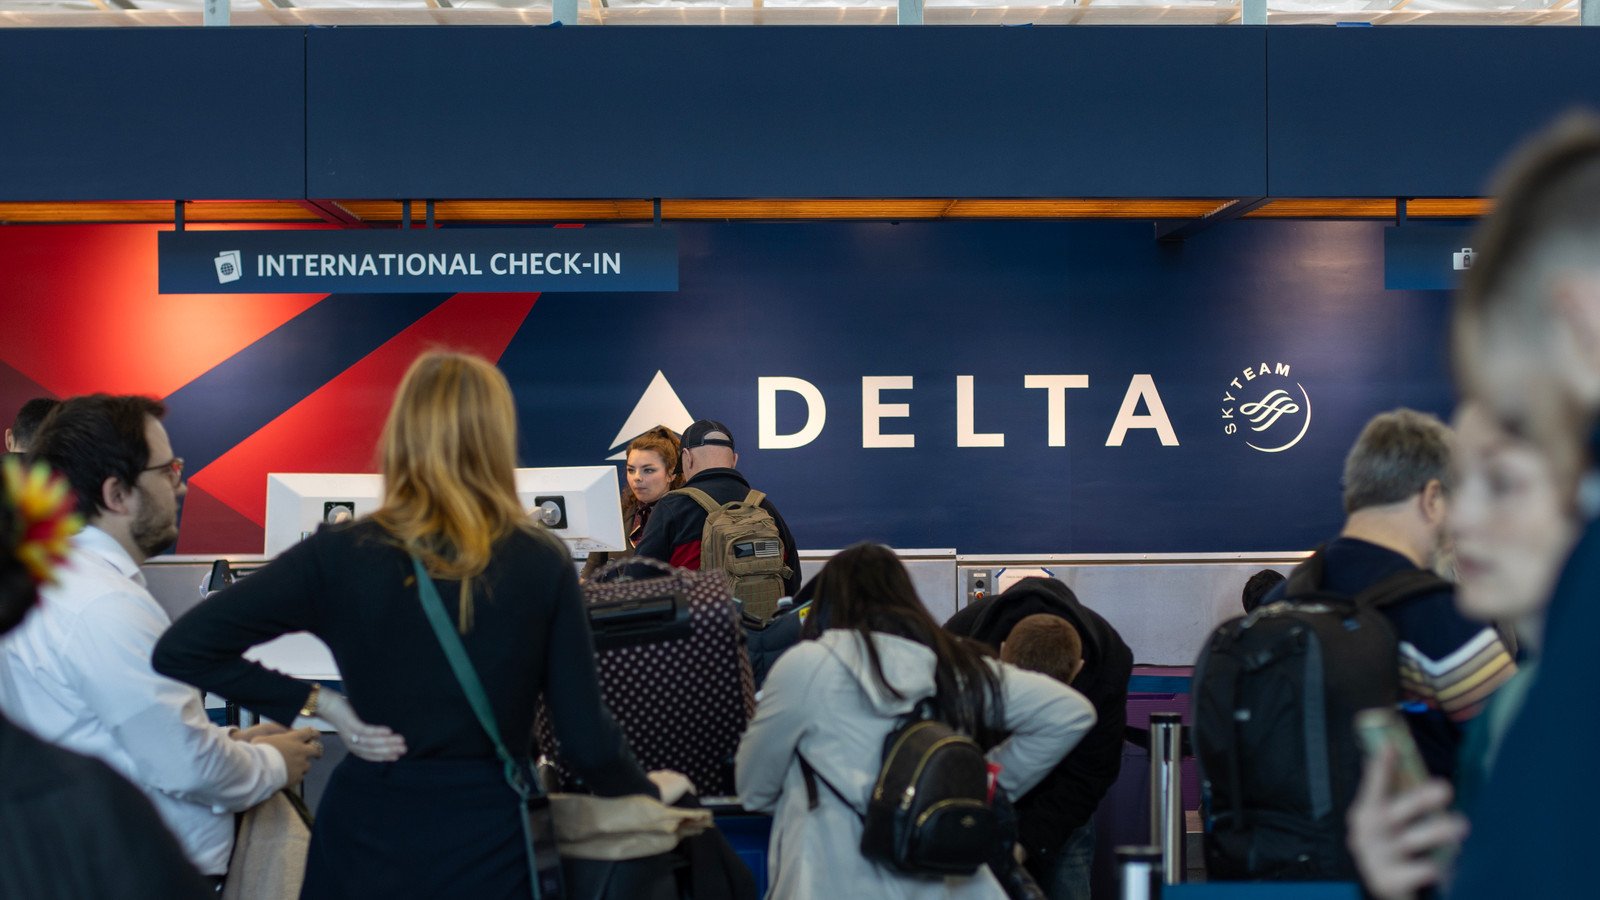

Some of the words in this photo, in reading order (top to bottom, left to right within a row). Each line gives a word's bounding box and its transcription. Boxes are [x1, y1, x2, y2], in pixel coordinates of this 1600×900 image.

[257, 253, 483, 277] INTERNATIONAL
[490, 252, 622, 276] CHECK-IN
[757, 373, 1181, 450] DELTA
[1221, 362, 1291, 435] SKYTEAM
